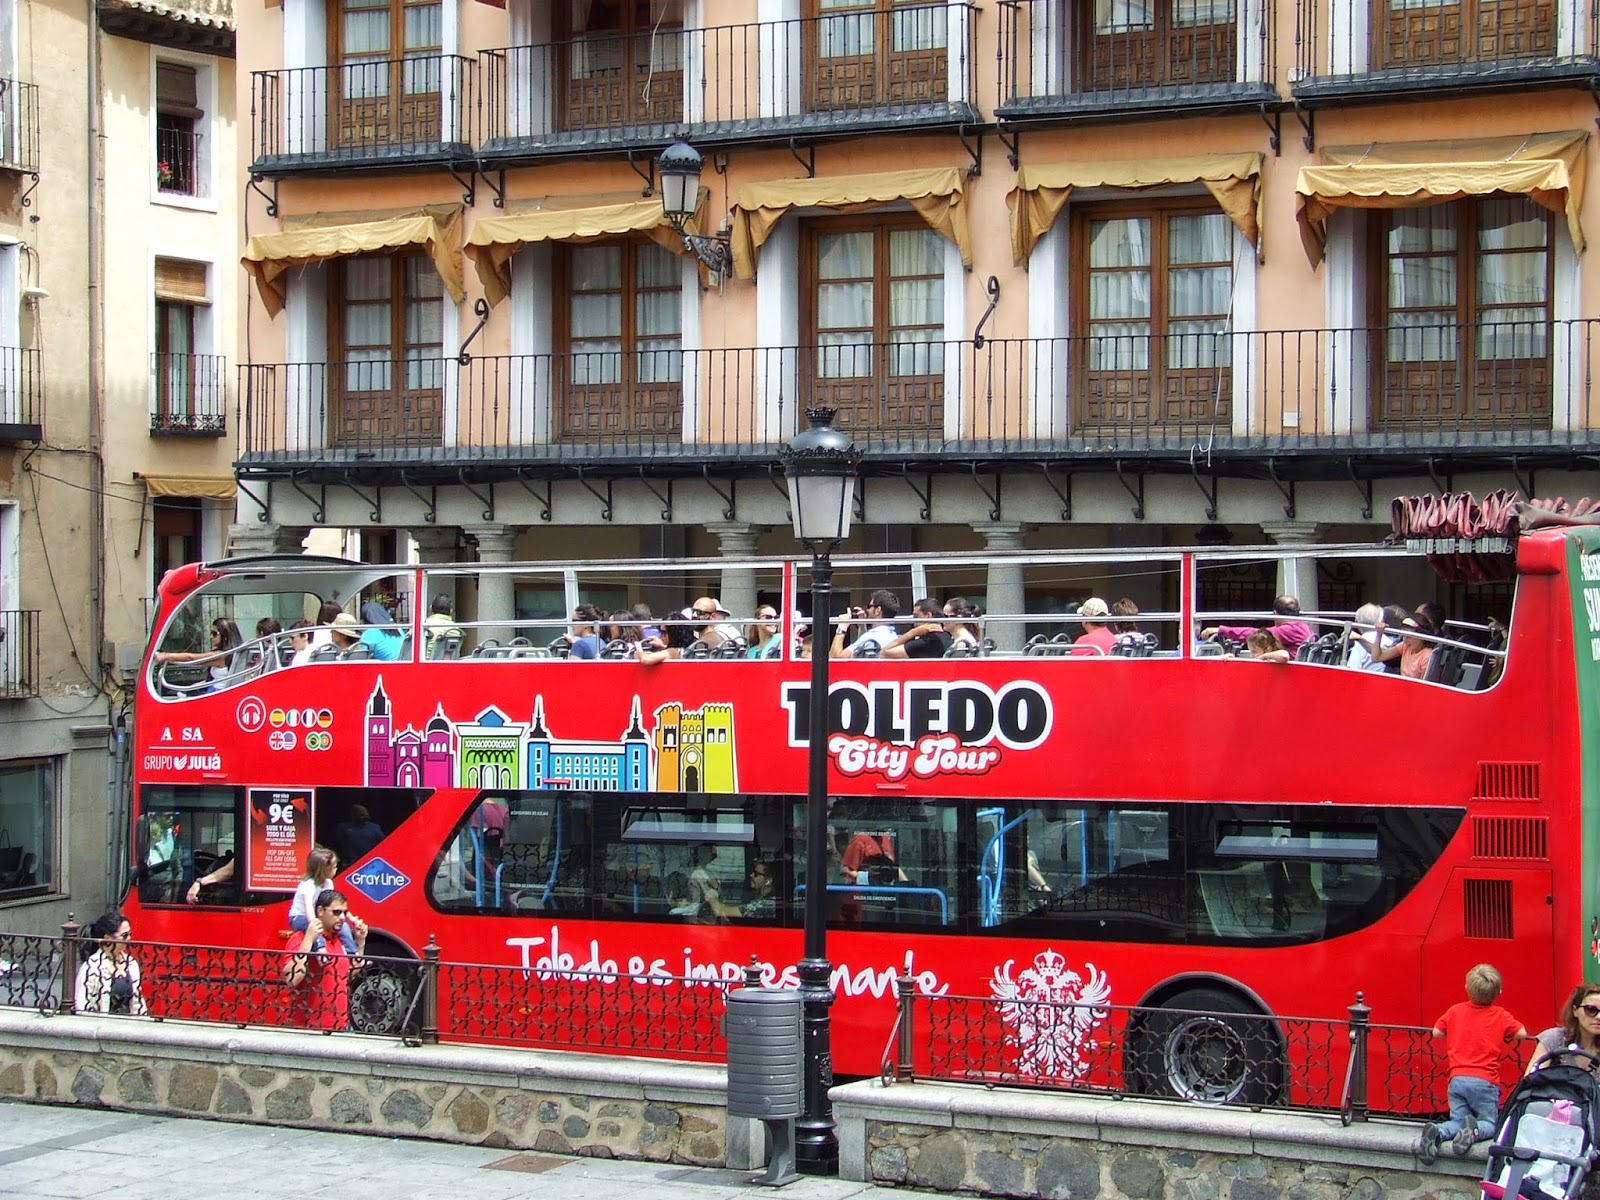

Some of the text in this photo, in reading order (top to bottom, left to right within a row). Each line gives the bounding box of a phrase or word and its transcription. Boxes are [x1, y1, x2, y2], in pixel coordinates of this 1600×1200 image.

[783, 682, 1051, 749] TOLEDO
[144, 755, 172, 770] GRUPO
[829, 736, 997, 777] City Tour
[269, 804, 294, 824] 9€
[351, 873, 405, 886] Gray Line
[506, 925, 619, 984] Toledo
[628, 956, 673, 986] es
